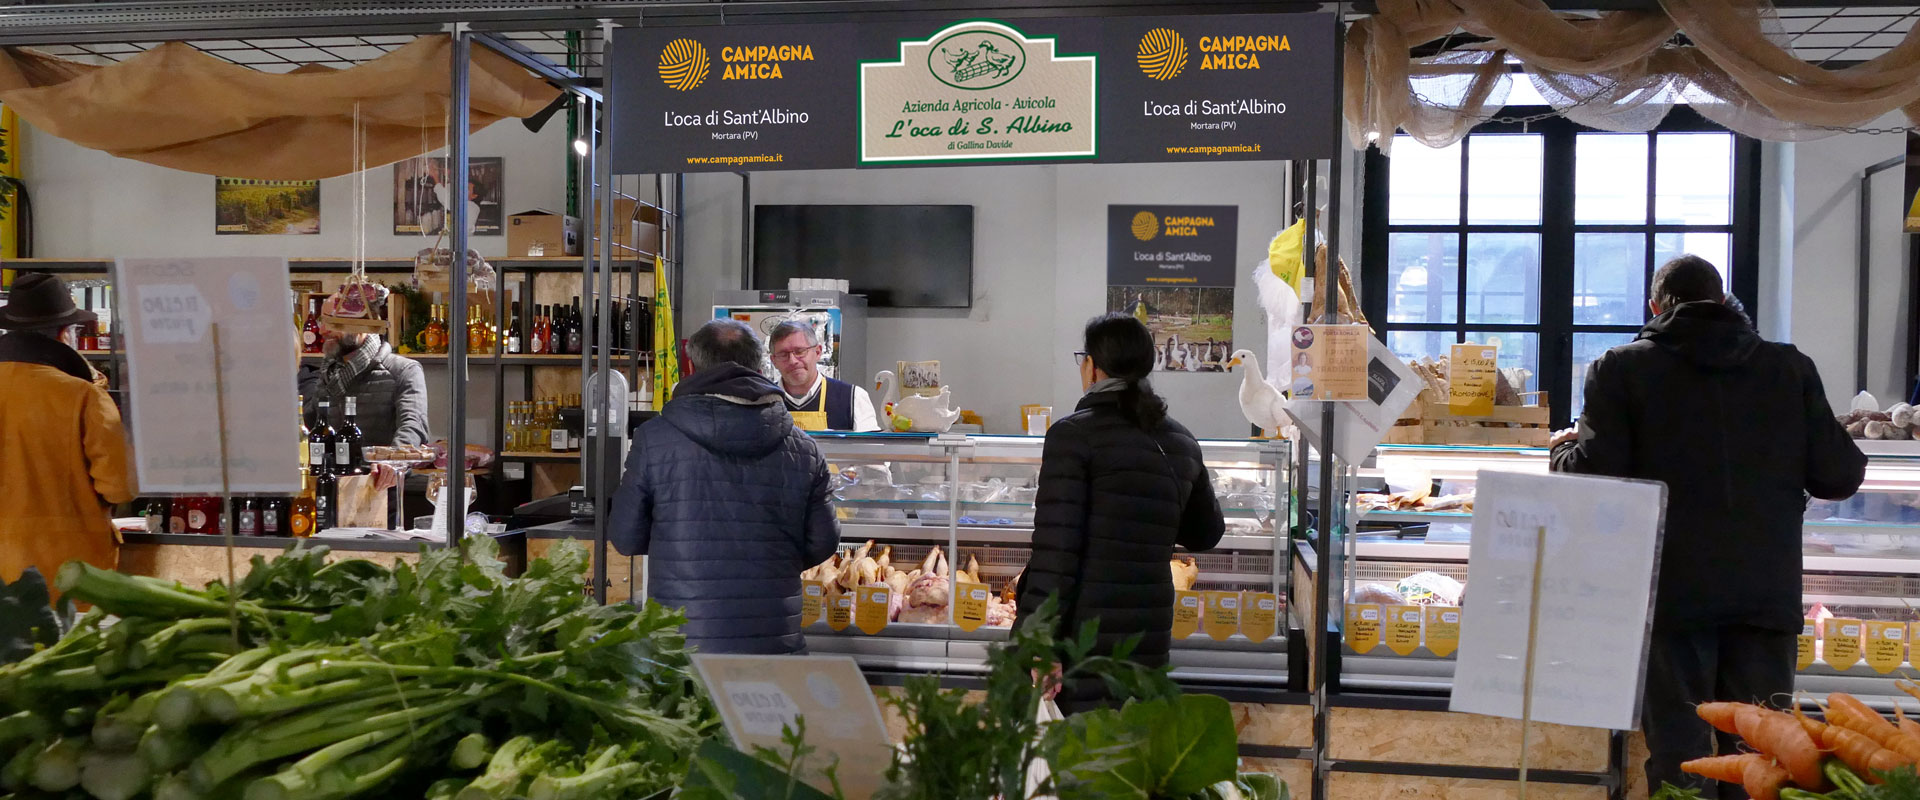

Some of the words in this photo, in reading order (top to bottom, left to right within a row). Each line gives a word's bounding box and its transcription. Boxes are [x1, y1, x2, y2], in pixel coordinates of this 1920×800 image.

[1199, 35, 1291, 52] CAMPAGNA
[721, 45, 814, 63] CAMPAGNA
[1200, 53, 1260, 70] AMICA
[722, 63, 783, 81] AMICA
[902, 100, 950, 113] Azienda
[953, 98, 1001, 113] Agricola
[1013, 96, 1056, 110] Avicola
[1144, 100, 1181, 116] L'oca
[1184, 99, 1198, 115] di
[1201, 98, 1287, 116] Sant'Albino
[664, 111, 702, 127] L'oca
[705, 109, 719, 126] di
[723, 109, 809, 126] Sant'Albino
[885, 119, 943, 139] L'oca
[947, 117, 970, 136] di
[976, 117, 998, 135] S.
[1005, 116, 1073, 135] Albino
[1190, 121, 1220, 130] Mortara
[1220, 121, 1237, 131] (PV)
[711, 132, 742, 141] Mortara
[743, 130, 759, 141] (PV)
[947, 142, 955, 150] di
[957, 140, 984, 150] Gallina
[986, 139, 1013, 149] Davide
[1166, 144, 1261, 156] www.campagnamica.it
[686, 153, 784, 166] www.campagnamica.it
[1164, 216, 1215, 227] CAMPAGNA
[1165, 227, 1198, 237] AMICA
[1134, 252, 1155, 261] L'oca
[1156, 251, 1164, 261] di
[1165, 252, 1212, 262] Sant'Albino
